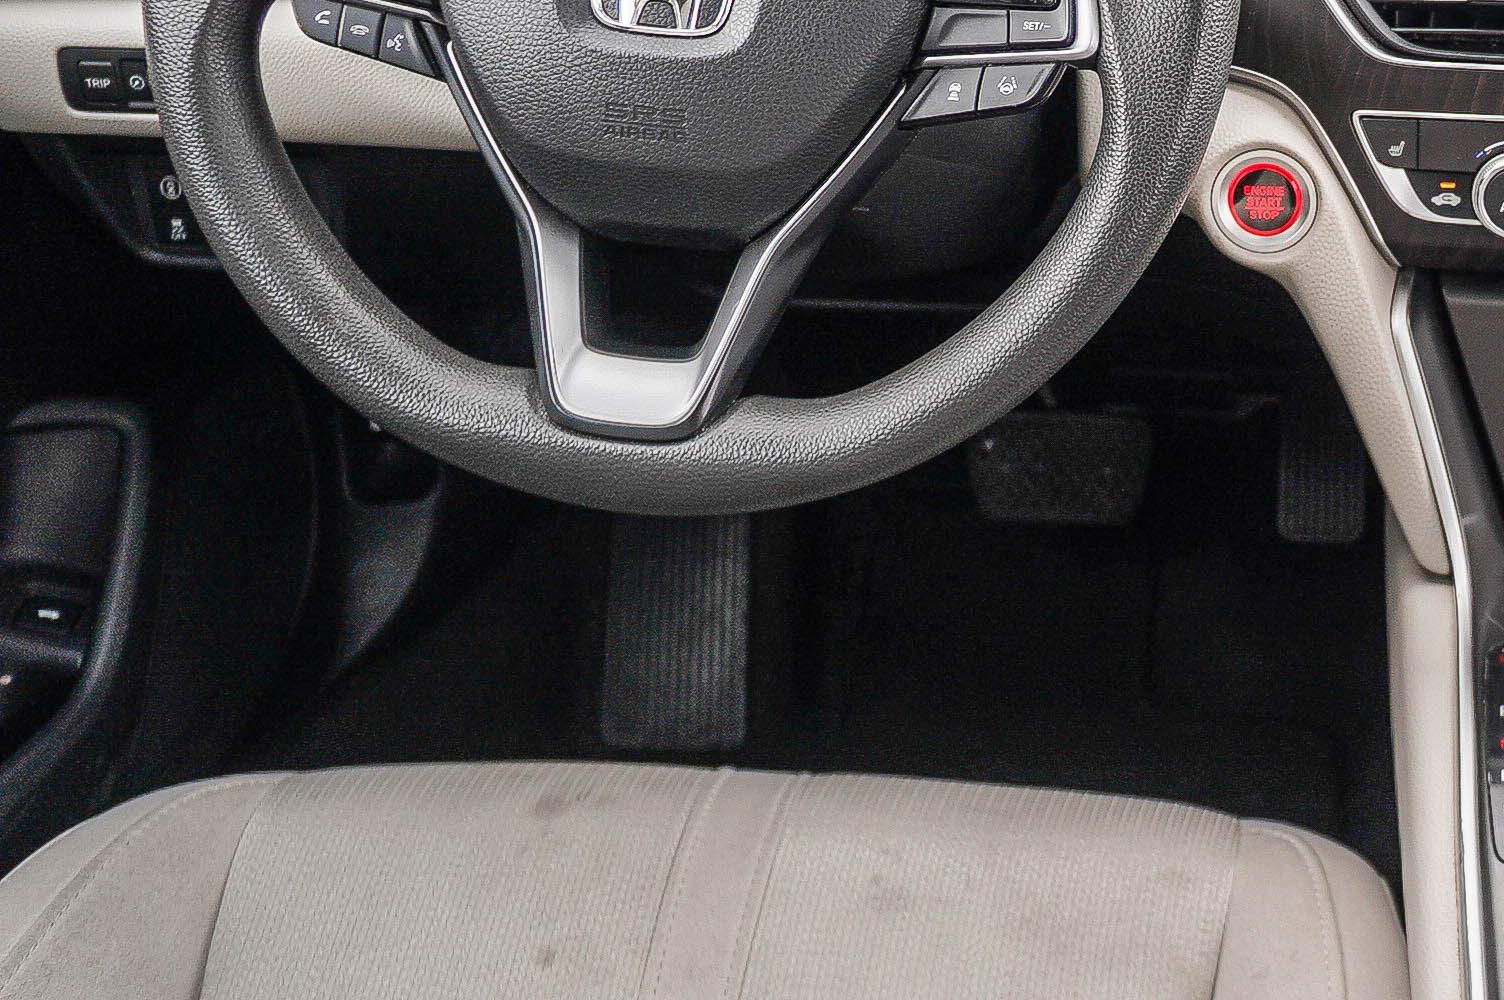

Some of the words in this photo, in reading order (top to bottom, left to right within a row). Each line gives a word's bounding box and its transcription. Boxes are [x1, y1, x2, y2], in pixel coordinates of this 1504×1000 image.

[84, 77, 111, 89] TRIP
[1243, 185, 1285, 197] ENGINE
[1246, 197, 1283, 208] START
[1249, 210, 1280, 220] STOP
